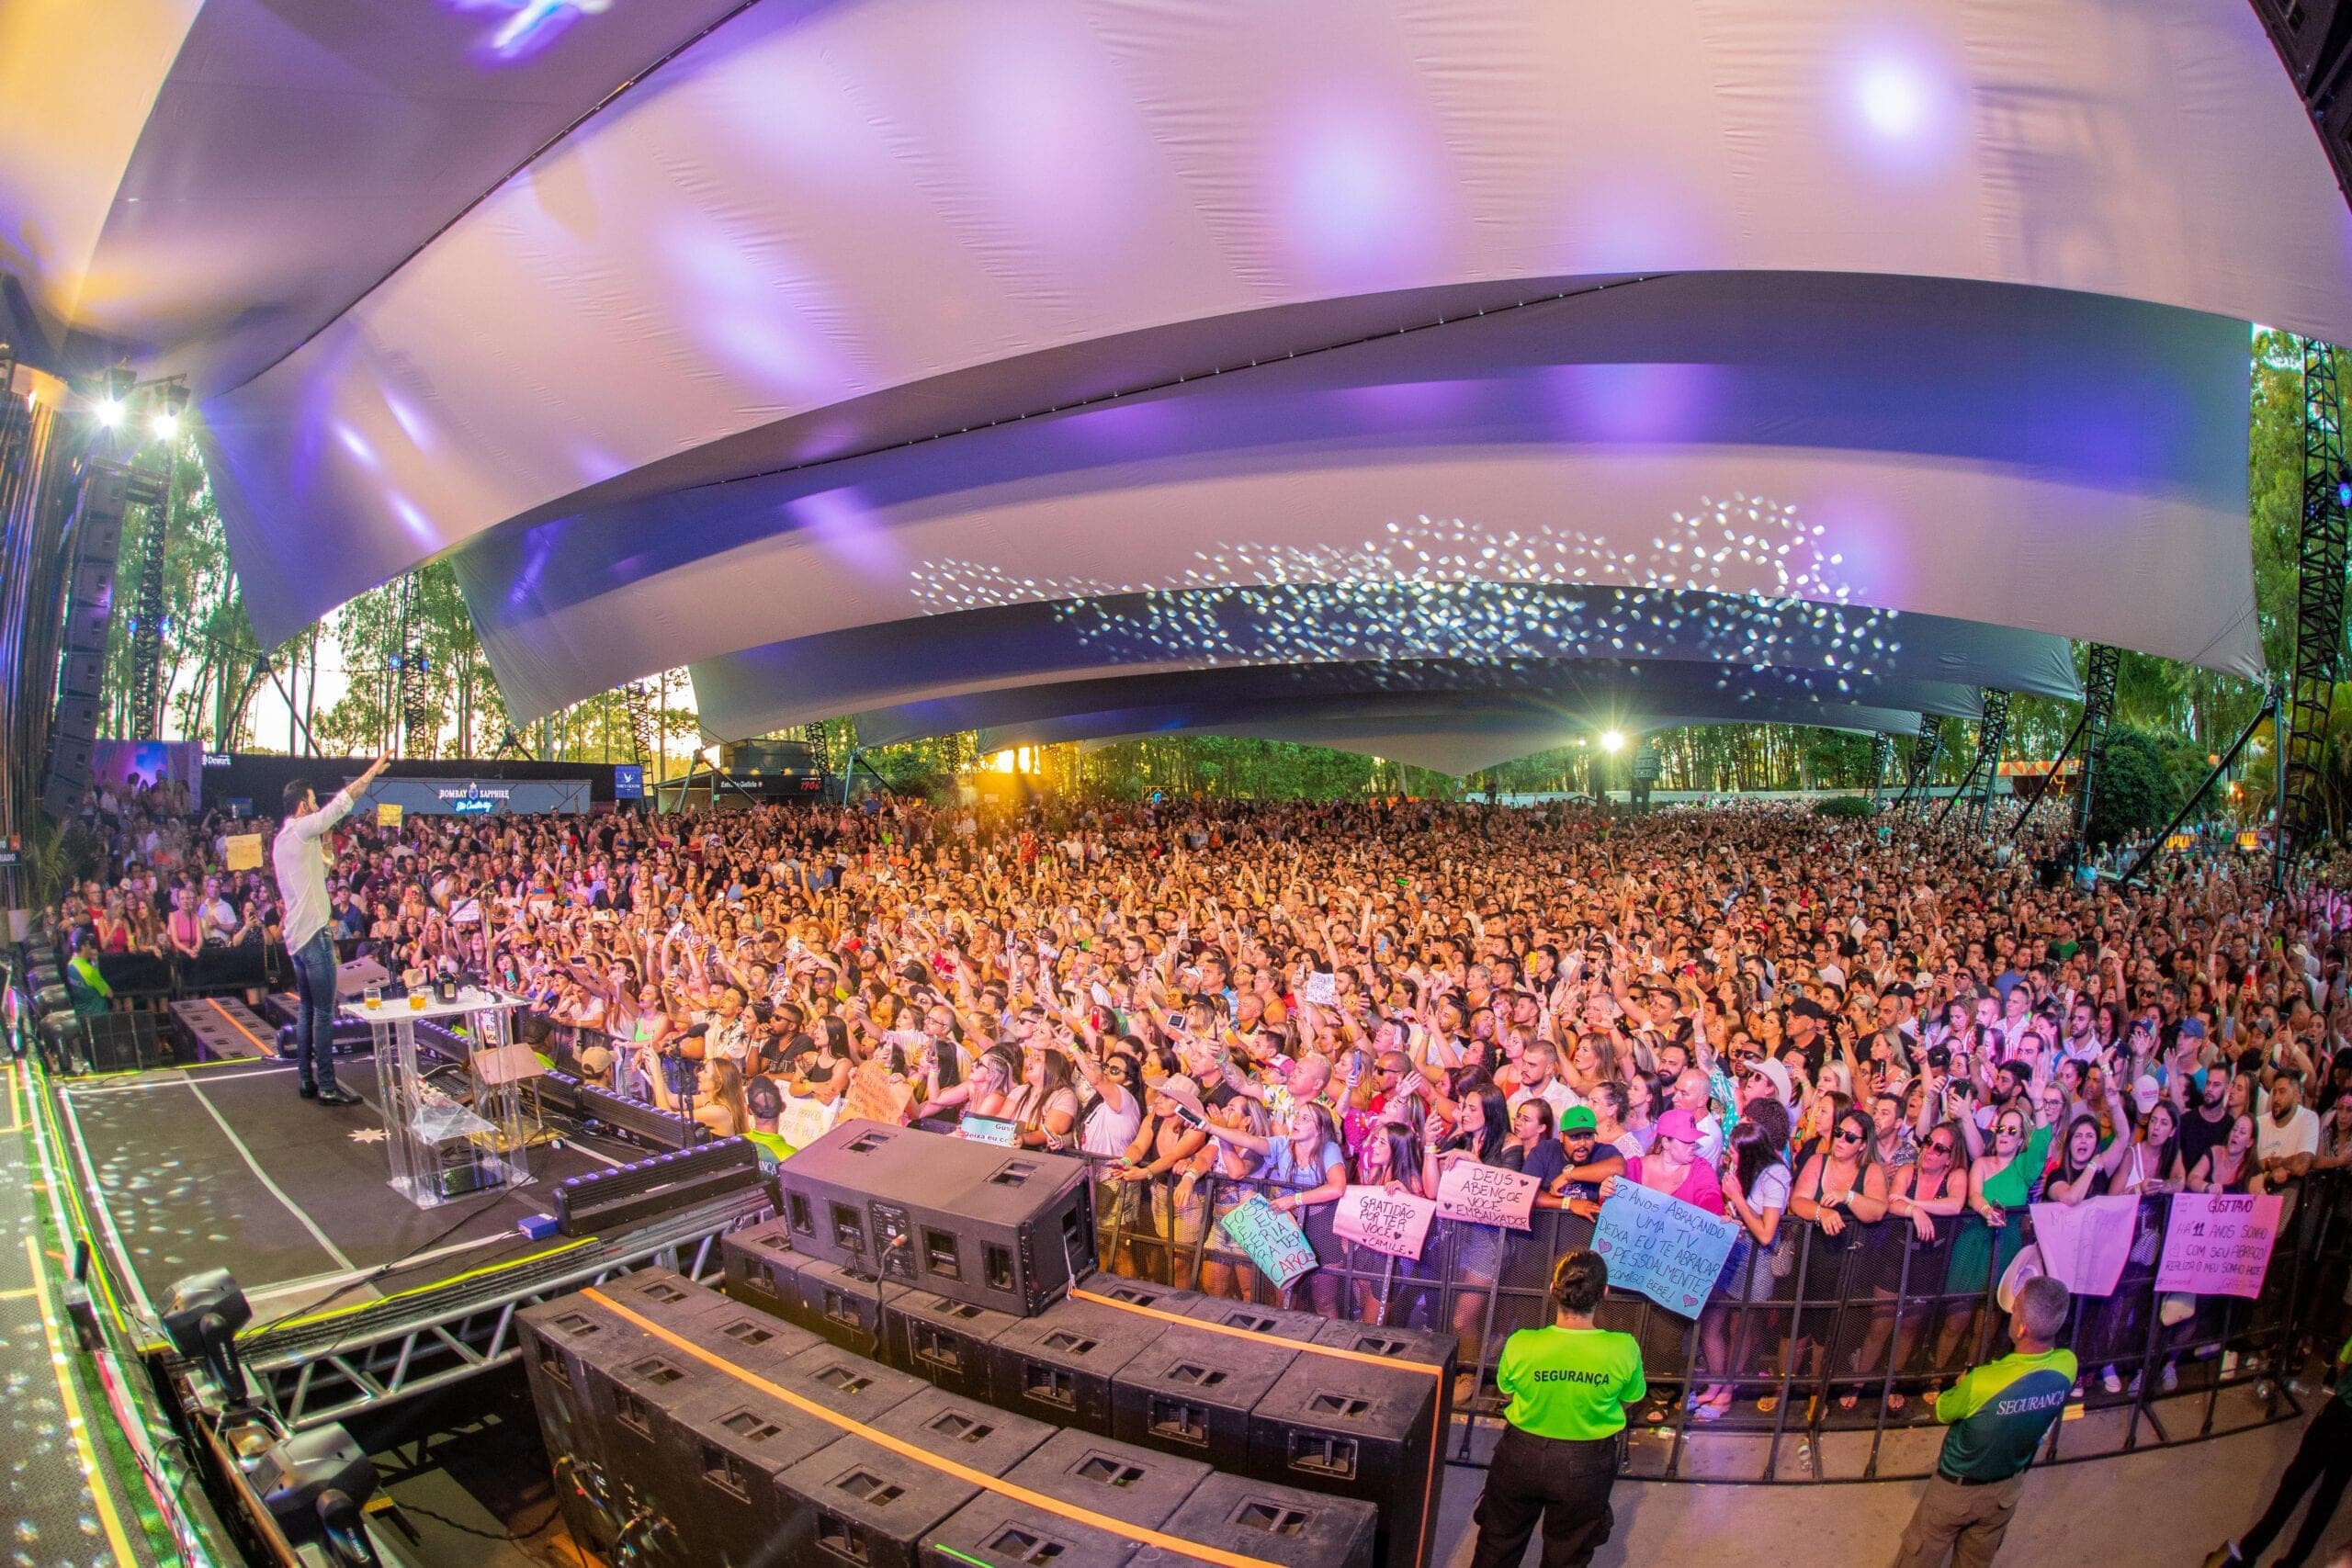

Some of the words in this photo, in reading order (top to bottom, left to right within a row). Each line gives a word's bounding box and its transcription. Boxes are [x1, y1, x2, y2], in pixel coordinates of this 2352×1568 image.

[1473, 1168, 1513, 1186] DEUS
[1460, 1180, 1522, 1203] ABENÇOE
[1360, 1196, 1416, 1219] GRATIDÃO
[1456, 1203, 1527, 1228] EMBAIXADOR
[2208, 1200, 2254, 1213] GUSTTAVO
[1359, 1208, 1380, 1224] POR
[1383, 1214, 1408, 1232] TER
[1636, 1213, 1665, 1234] UMA
[1676, 1229, 1699, 1248] TV
[1599, 1215, 1629, 1244] DEIXA
[1634, 1235, 1656, 1250] EU
[1659, 1240, 1674, 1258] TE
[2208, 1224, 2235, 1239] ANOS
[1368, 1236, 1407, 1255] CAMILE
[2186, 1243, 2206, 1257] COM
[2210, 1247, 2229, 1258] SEU
[1533, 1370, 1610, 1388] SEGURANÇA
